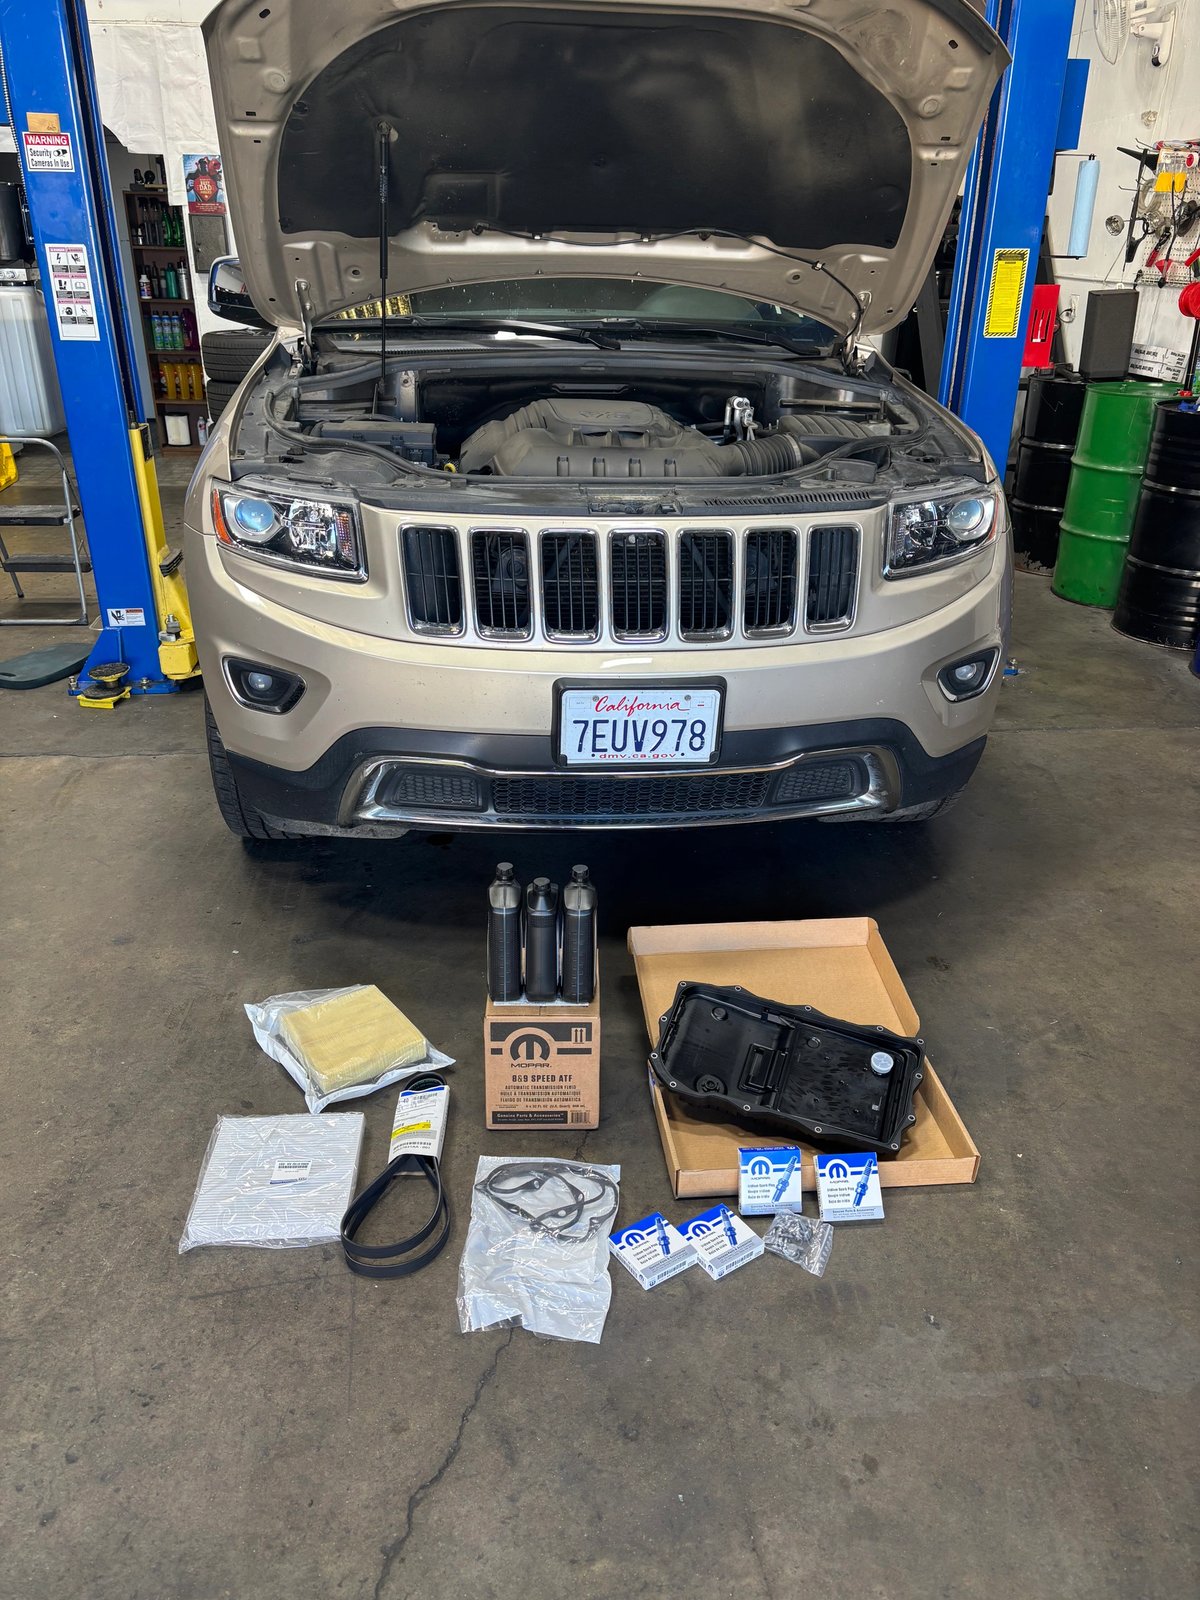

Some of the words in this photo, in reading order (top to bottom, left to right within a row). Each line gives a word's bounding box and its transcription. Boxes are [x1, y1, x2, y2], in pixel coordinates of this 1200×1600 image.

[26, 135, 68, 145] WARNING
[30, 148, 52, 158] Security
[31, 158, 54, 167] Cameras
[54, 159, 59, 167] In
[60, 159, 70, 168] Use
[594, 696, 690, 717] California
[572, 720, 706, 752] 7EUV978
